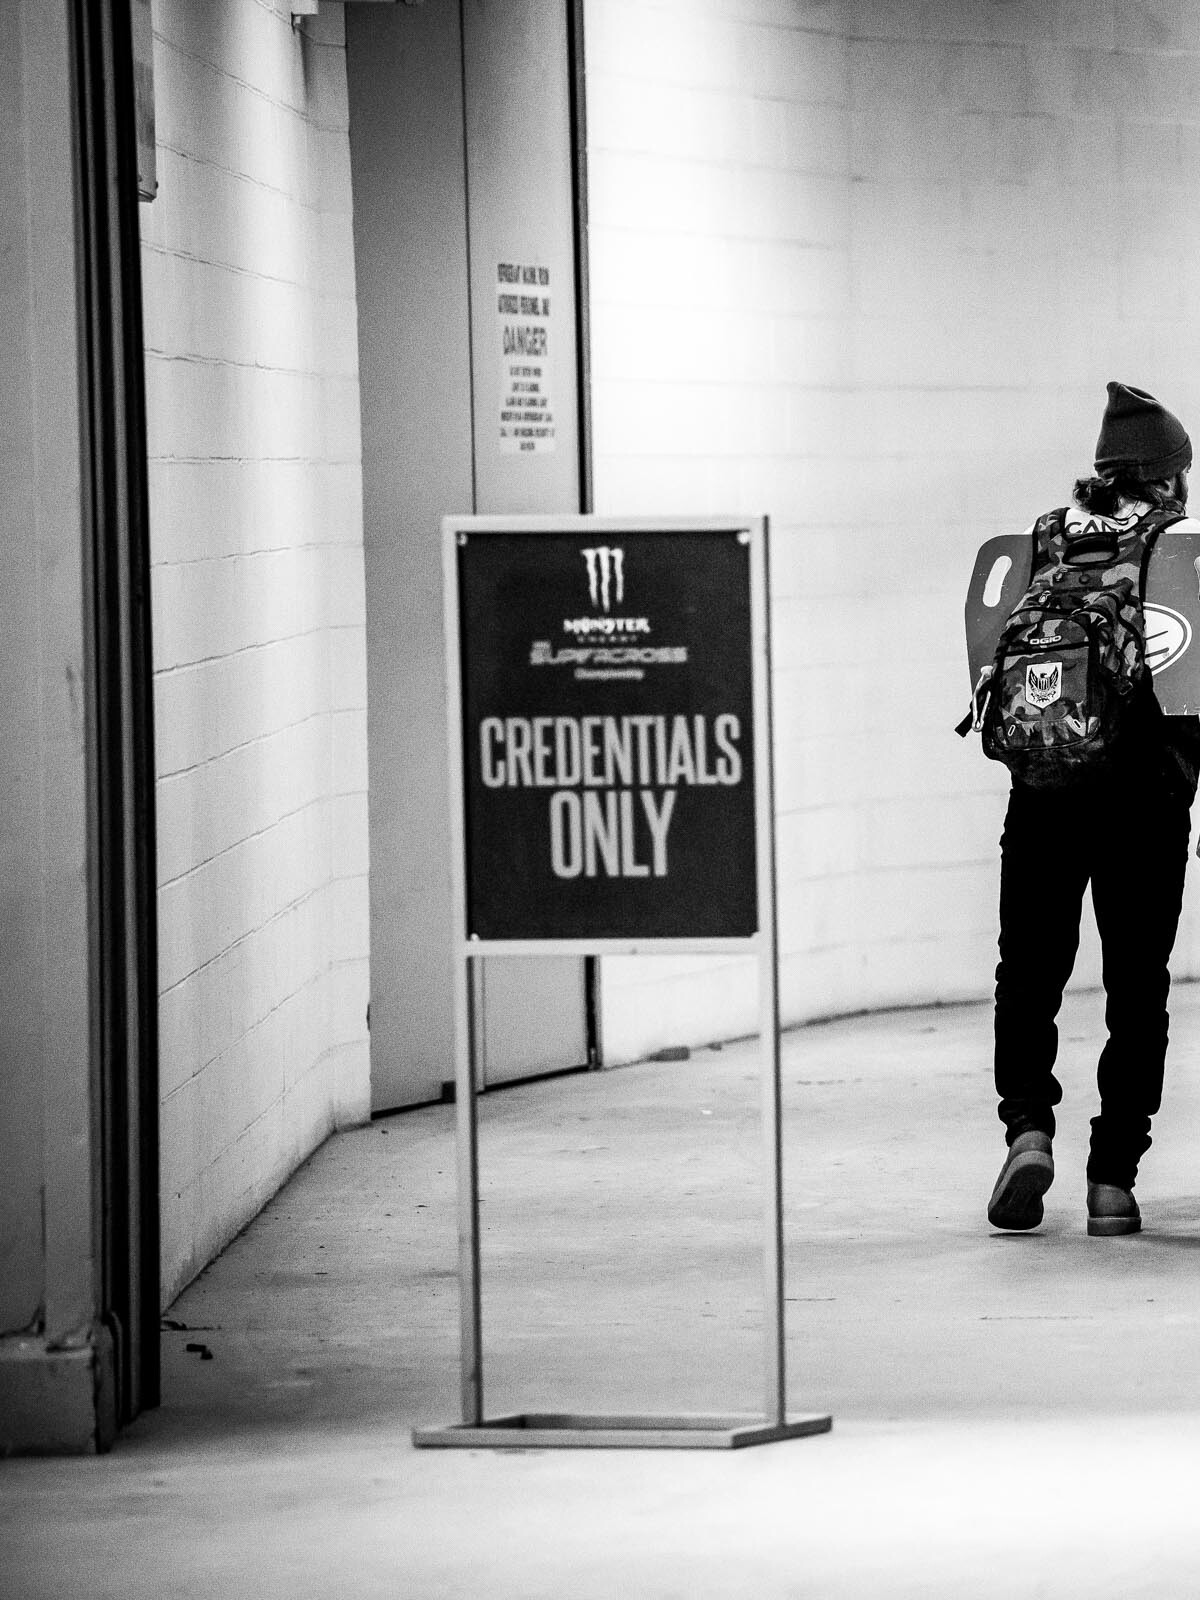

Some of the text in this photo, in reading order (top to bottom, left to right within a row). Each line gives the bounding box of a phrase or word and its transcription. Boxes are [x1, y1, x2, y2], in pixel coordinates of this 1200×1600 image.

[1064, 519, 1120, 534] CAN
[1029, 635, 1062, 645] OGIO
[479, 713, 743, 788] CREDENTIALS
[549, 789, 676, 879] ONLY
